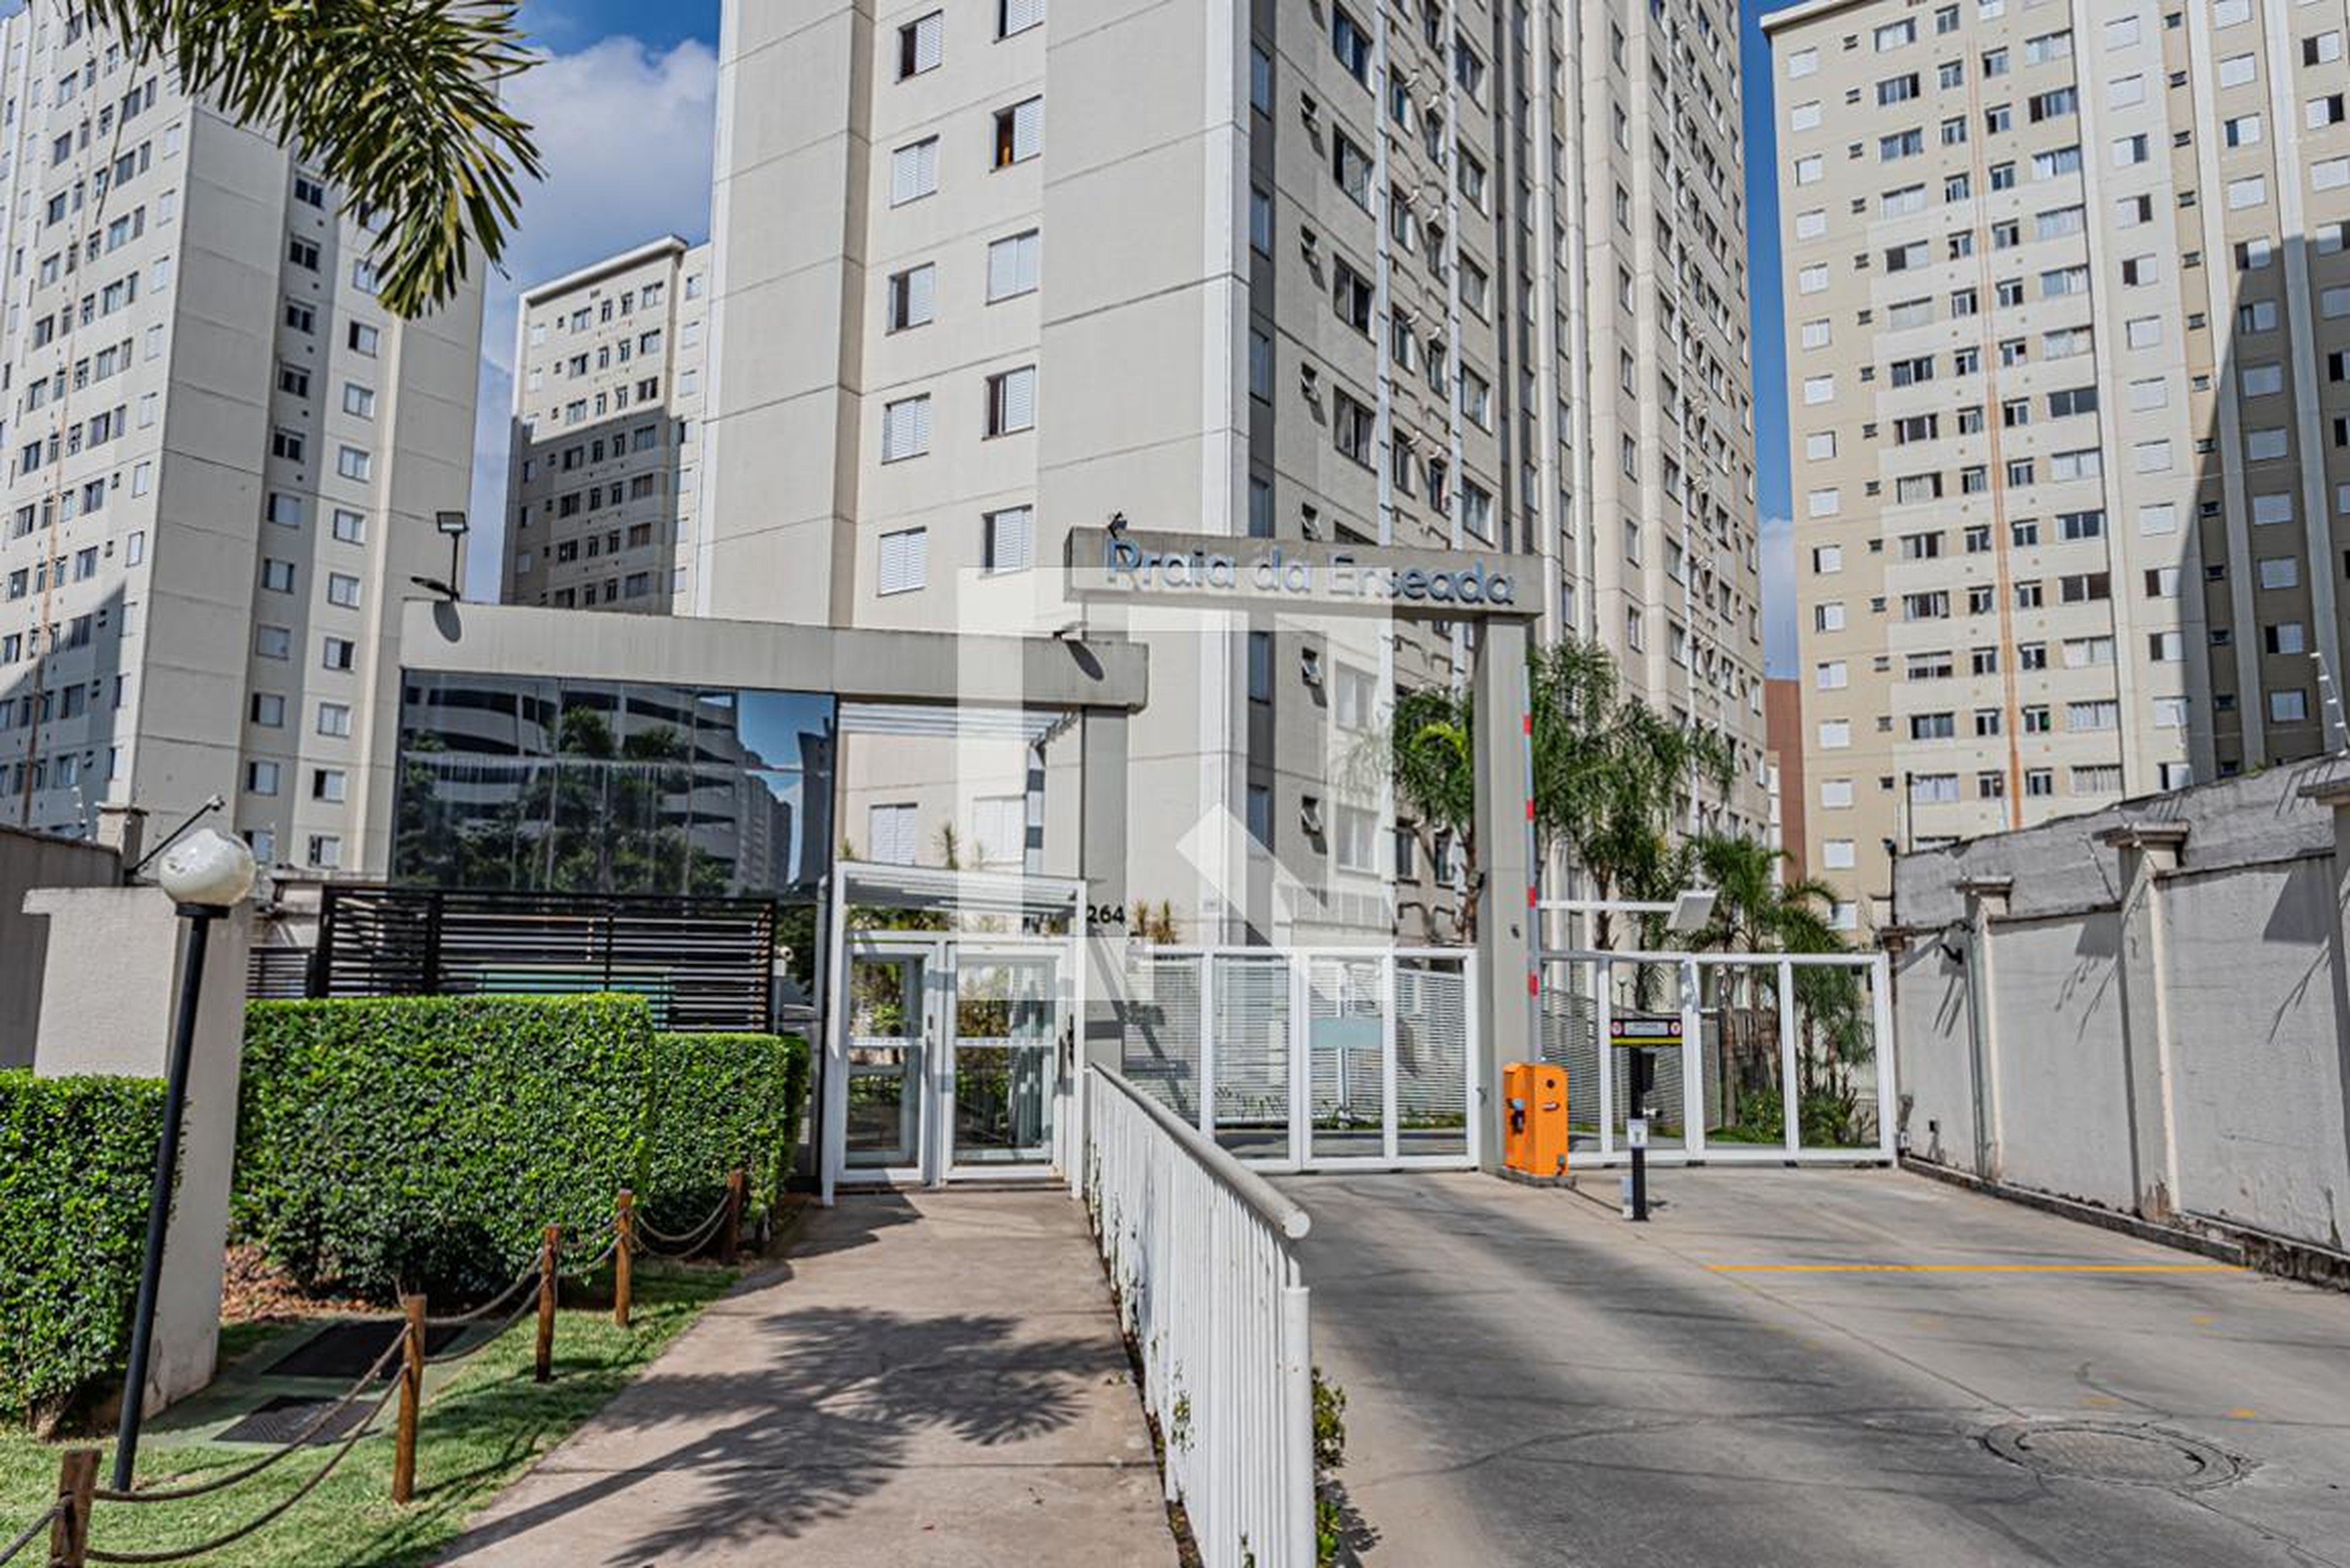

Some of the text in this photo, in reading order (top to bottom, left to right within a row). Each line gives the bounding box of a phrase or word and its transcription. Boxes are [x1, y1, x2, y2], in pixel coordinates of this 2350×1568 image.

[1106, 538, 1514, 605] Praia da Enseada
[1087, 905, 1125, 924] 264
